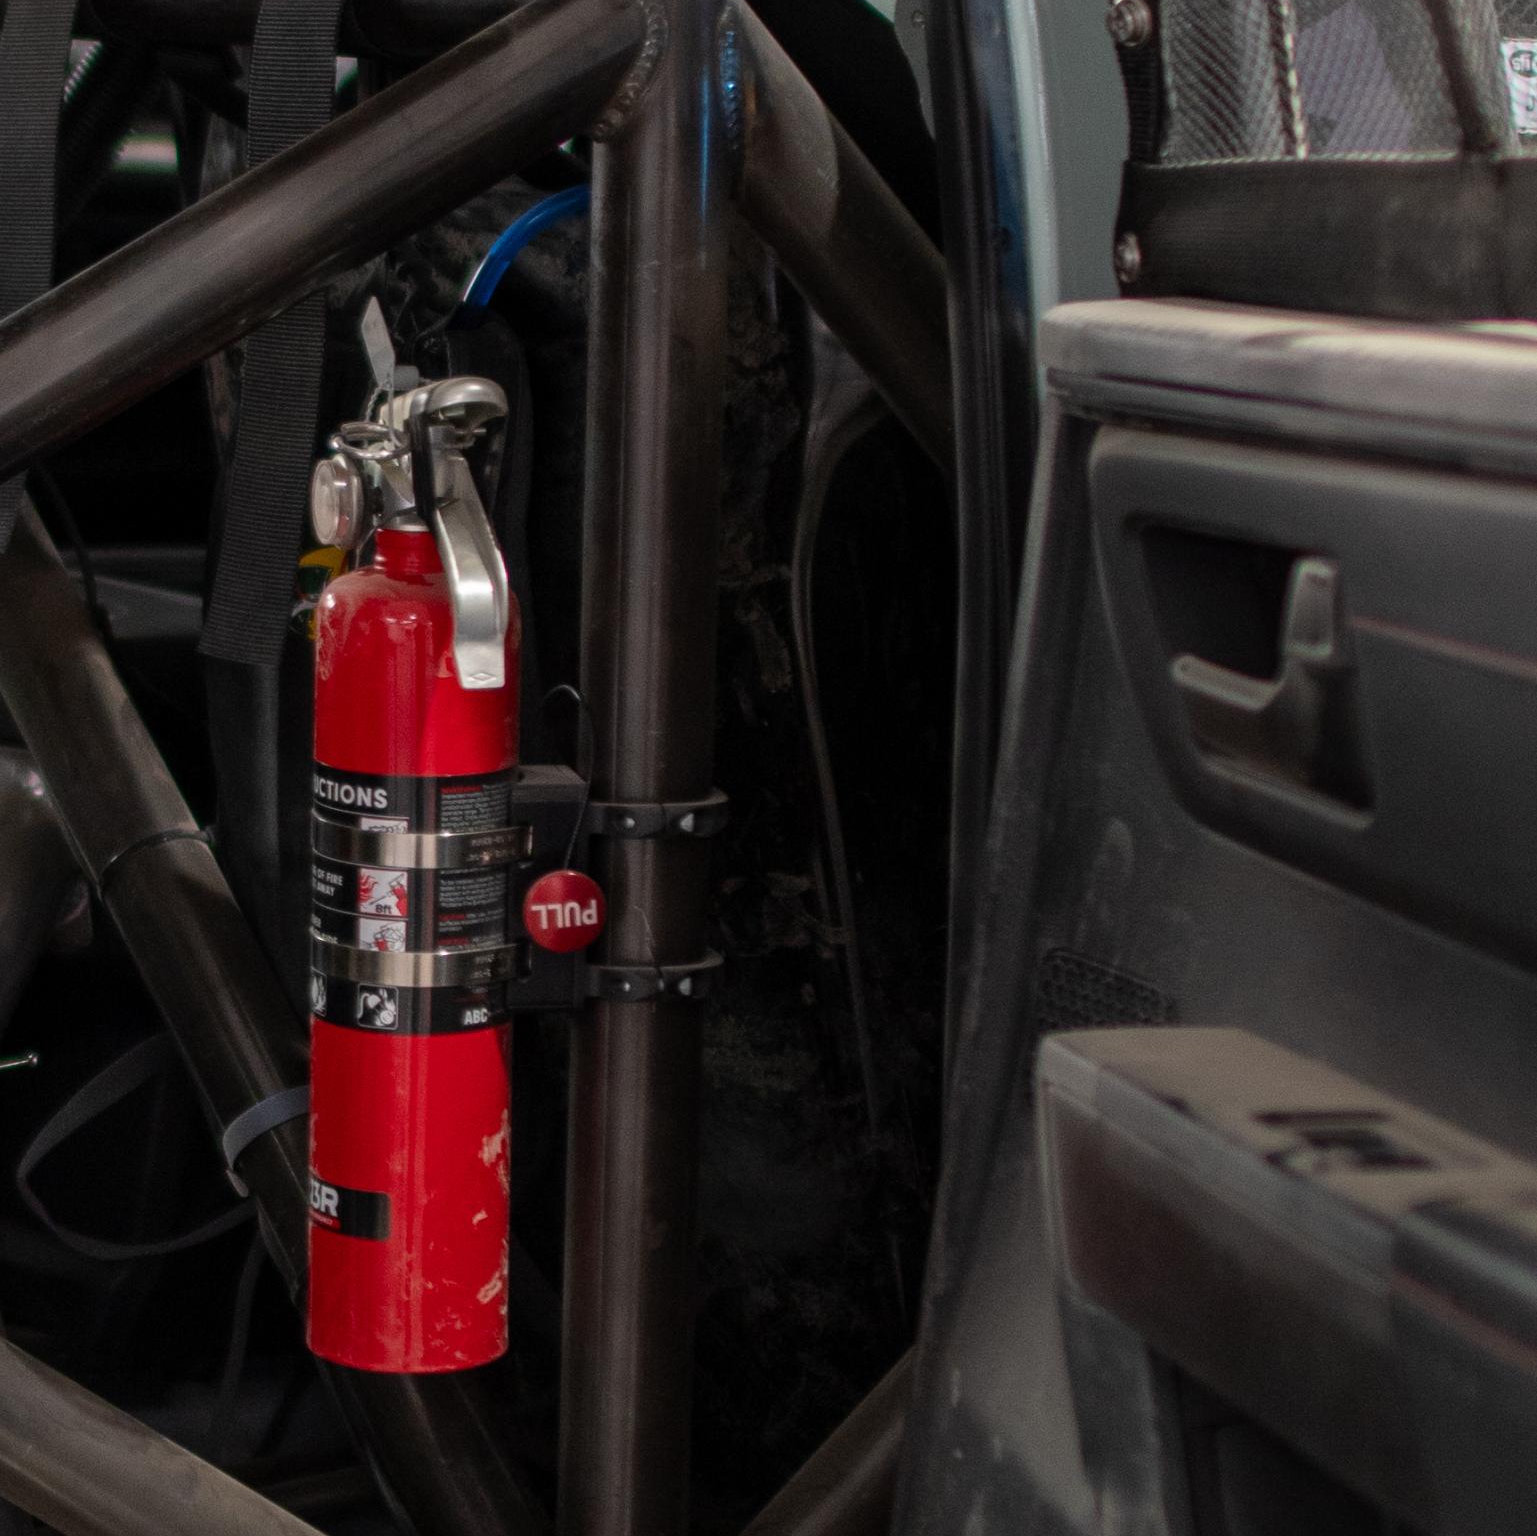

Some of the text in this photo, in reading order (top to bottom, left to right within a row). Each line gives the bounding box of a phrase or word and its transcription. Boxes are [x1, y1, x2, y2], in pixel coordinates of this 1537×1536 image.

[326, 871, 343, 886] FIRE
[531, 899, 598, 930] PULL
[464, 1007, 488, 1026] ABC
